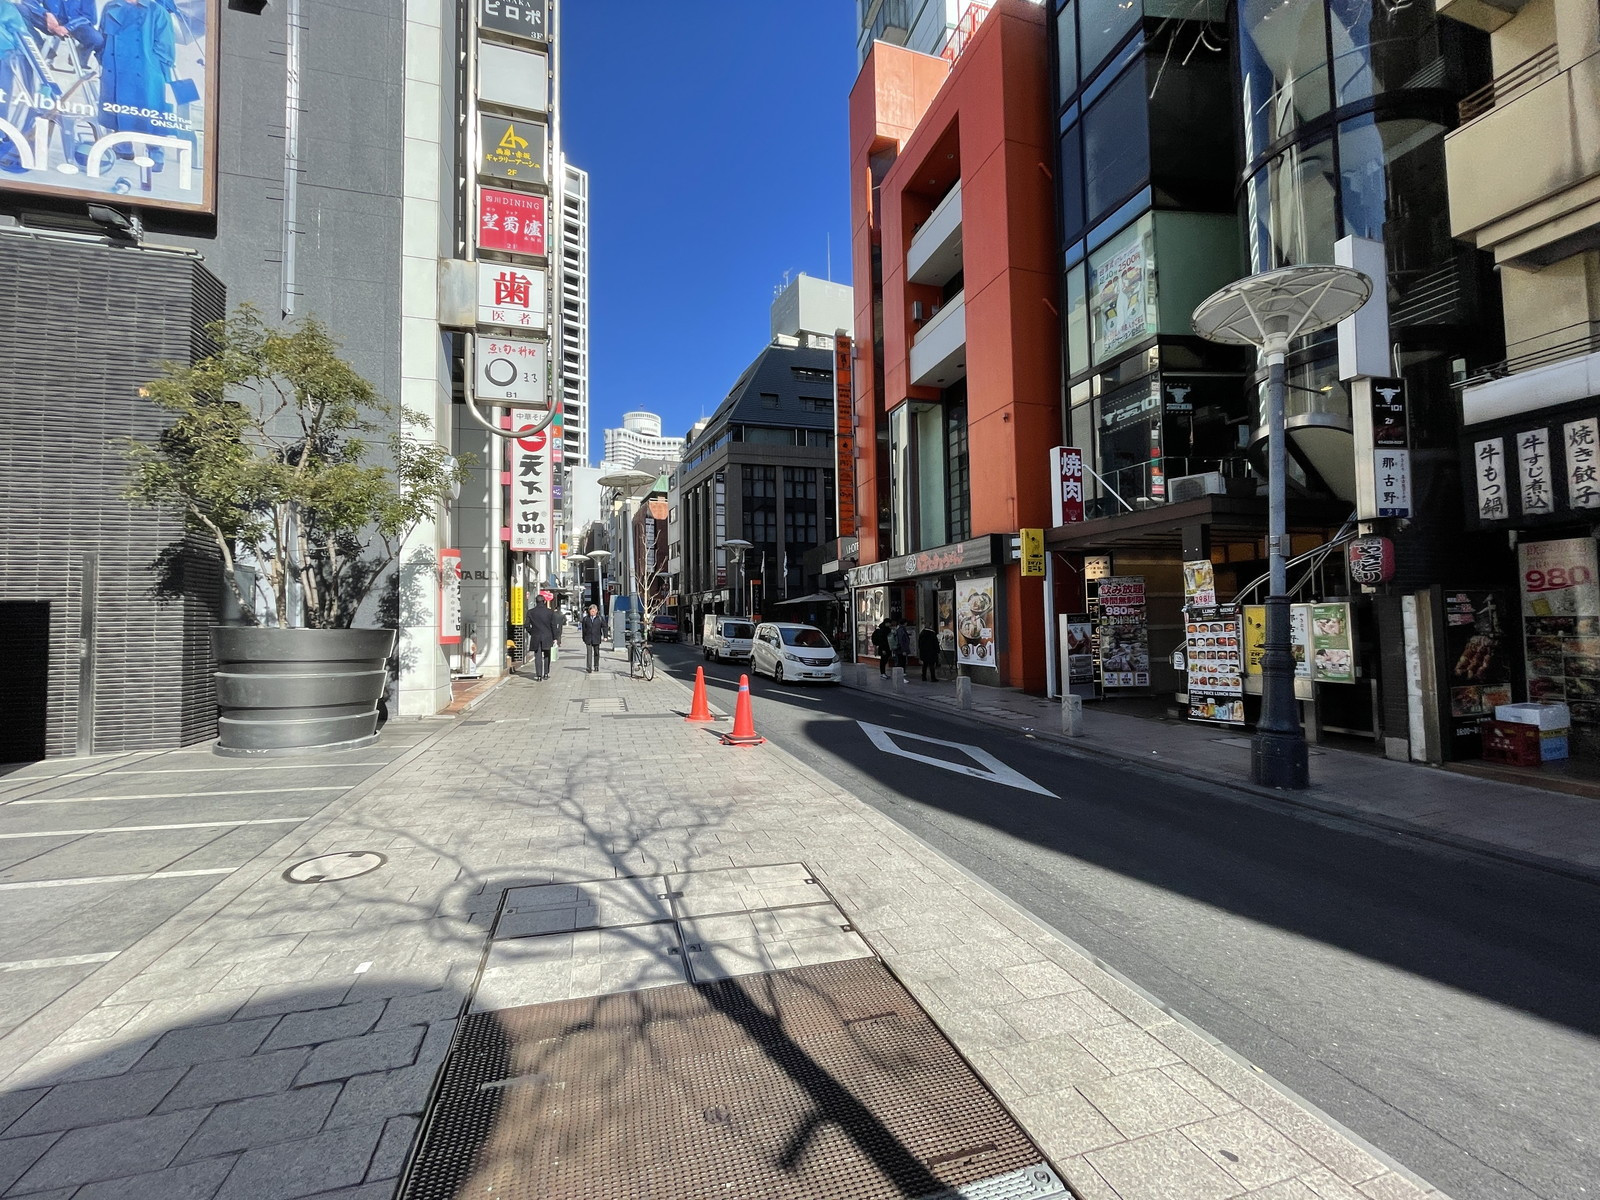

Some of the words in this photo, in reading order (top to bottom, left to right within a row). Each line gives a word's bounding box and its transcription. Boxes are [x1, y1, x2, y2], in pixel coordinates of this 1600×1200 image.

[485, 0, 541, 25] ピロポ
[530, 31, 543, 40] 3F
[13, 92, 94, 116] Album
[102, 102, 177, 121] 2025.02.18
[507, 168, 518, 176] 2F
[493, 271, 533, 309] 歯
[492, 310, 531, 326] 医者
[506, 390, 518, 399] B1
[1522, 434, 1548, 509] 牛すじ煮込
[1569, 425, 1600, 504] 焼き餃子
[1061, 452, 1082, 503] 焼肉
[1382, 457, 1396, 504] 那古野
[1479, 444, 1503, 520] 牛もつ鍋
[518, 453, 546, 534] 天下一品
[1100, 583, 1145, 595] 飲み放題
[1526, 566, 1590, 589] 980
